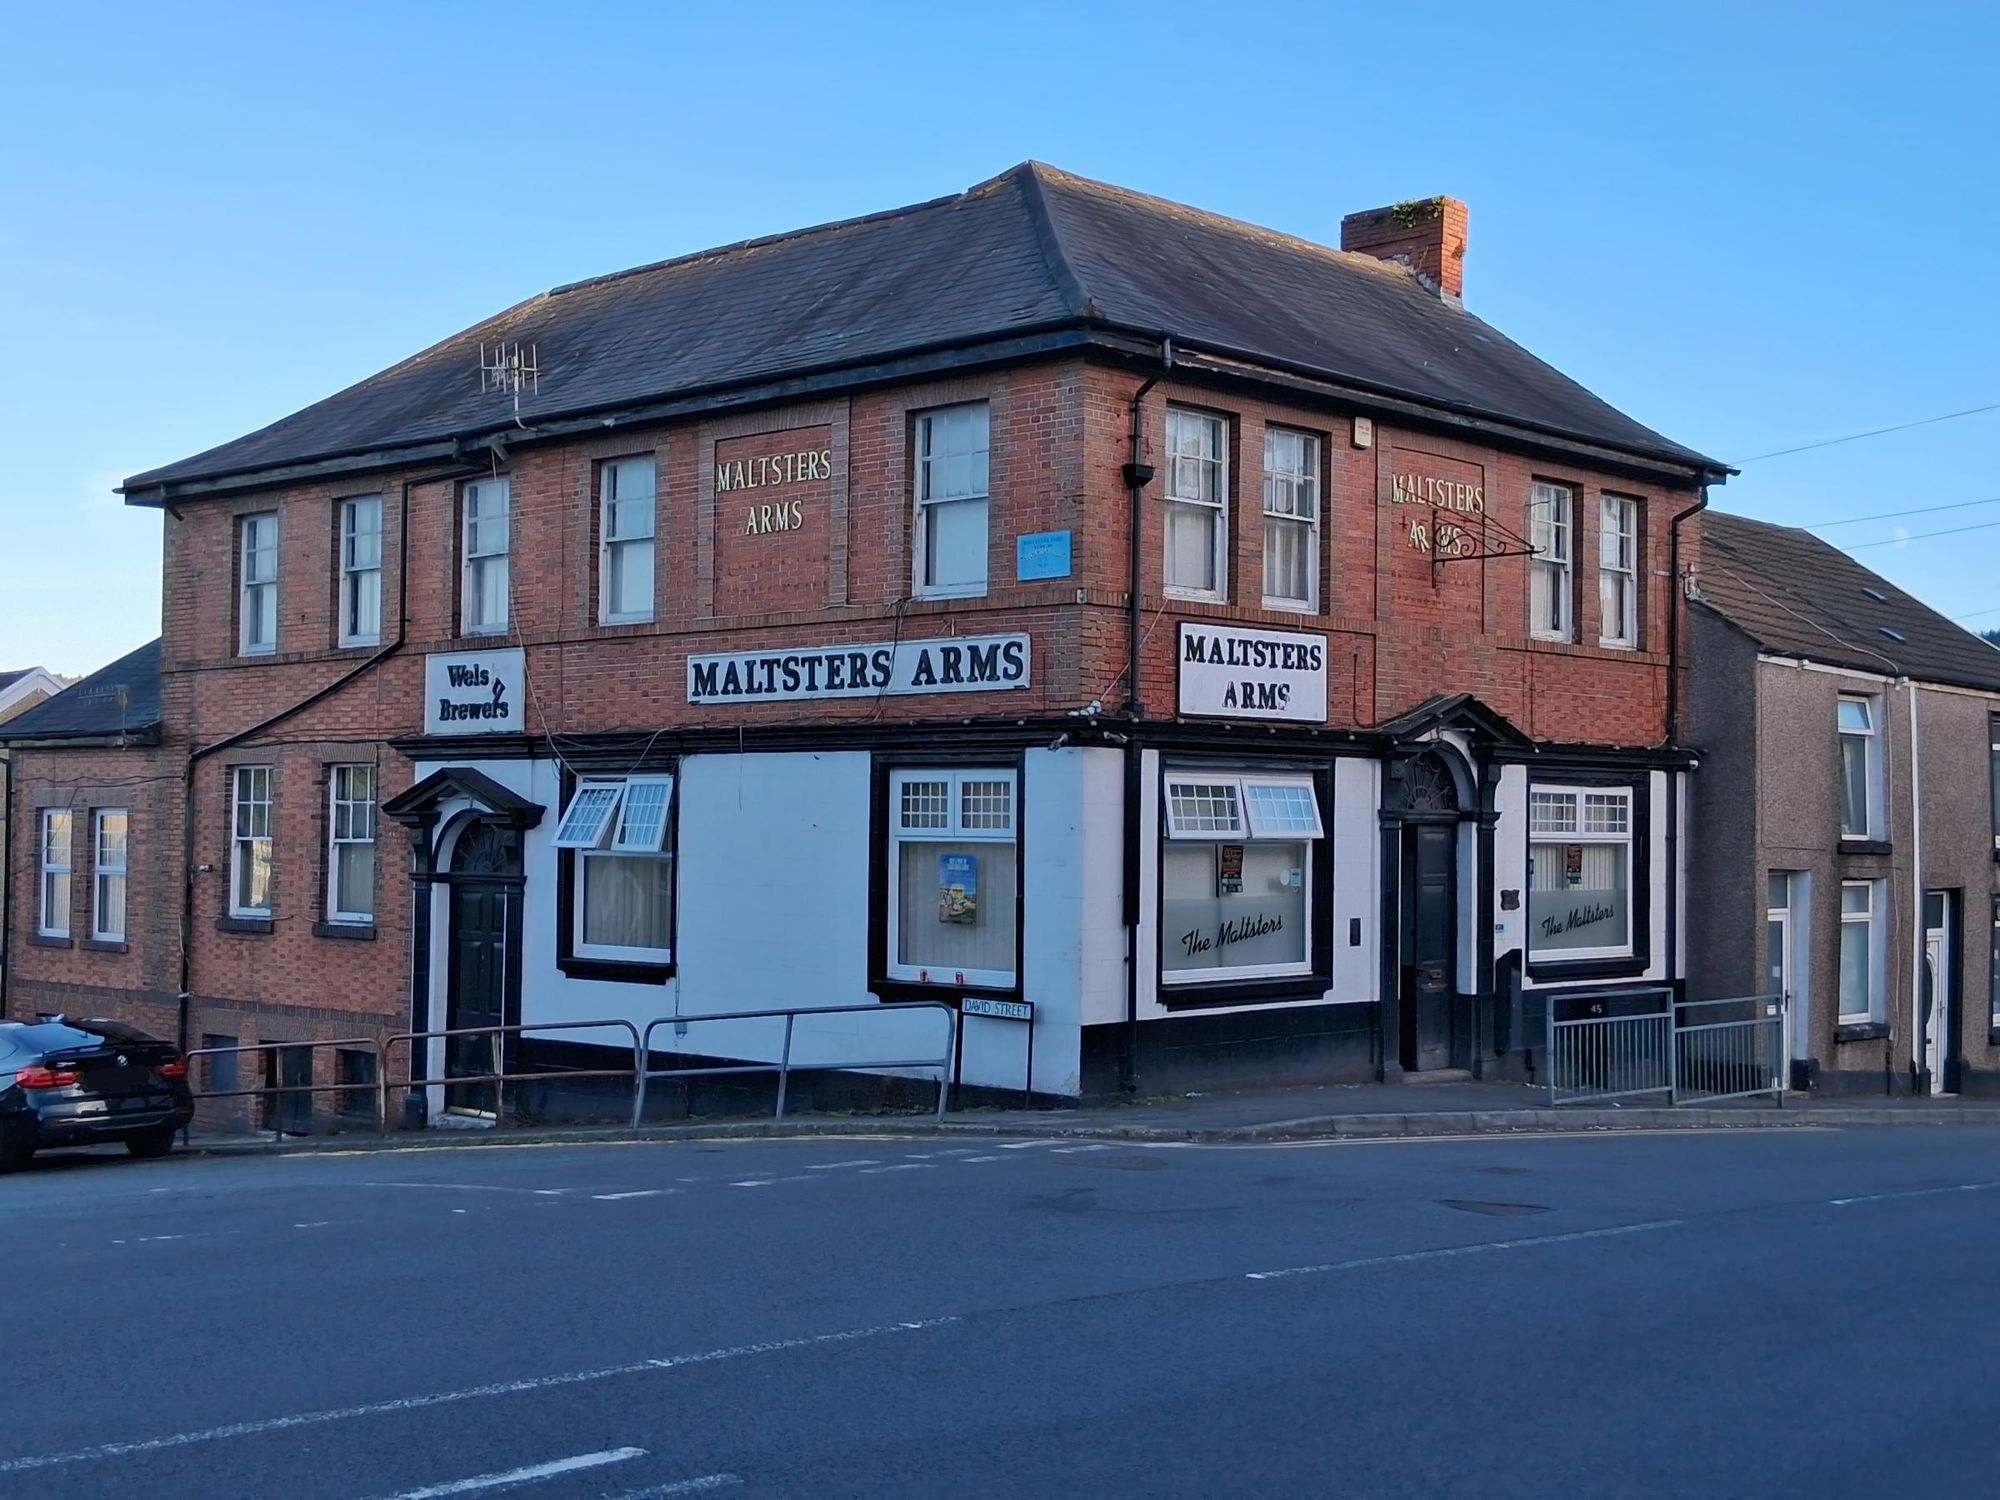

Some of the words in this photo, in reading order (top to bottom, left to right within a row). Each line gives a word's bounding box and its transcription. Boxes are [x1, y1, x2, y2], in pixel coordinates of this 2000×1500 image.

[717, 449, 831, 492] MALTSTERS
[1392, 473, 1483, 514] MALTSTERS
[745, 500, 803, 535] ARMS
[692, 650, 891, 697] MALTSTERS
[911, 641, 1023, 686] ARMS
[1184, 634, 1322, 671] MALTSTERS
[1222, 680, 1290, 711] ARMS
[1181, 928, 1211, 957] The
[1215, 913, 1283, 948] Maltsters
[1541, 914, 1562, 938] The
[1565, 902, 1614, 932] Maltsters
[964, 1000, 991, 1013] DAVID
[994, 1002, 1028, 1016] STREET
[1590, 1004, 1602, 1013] 45
